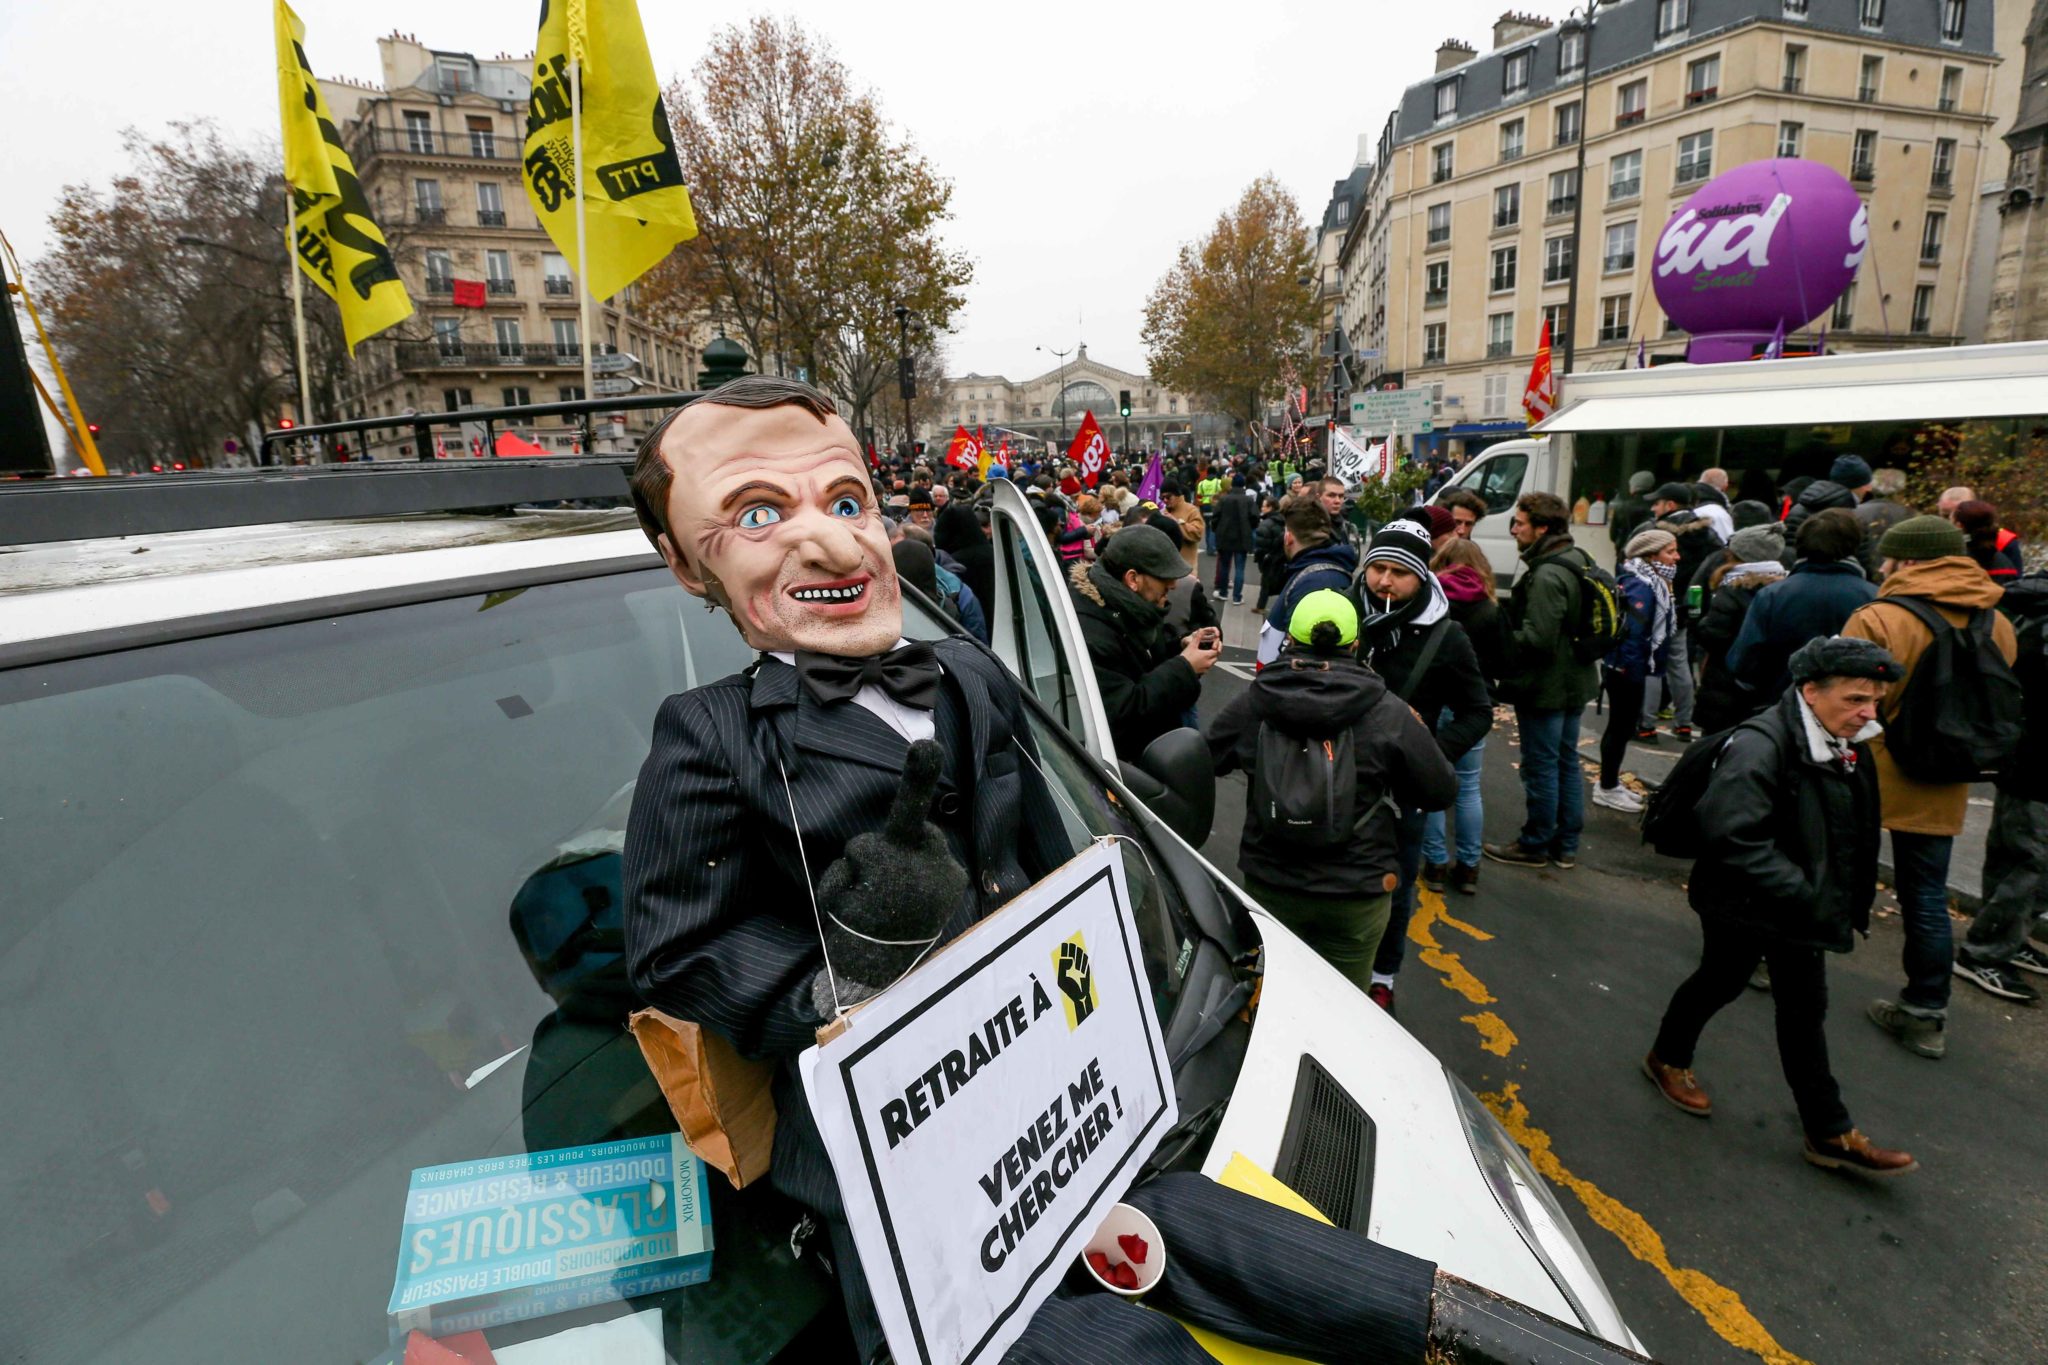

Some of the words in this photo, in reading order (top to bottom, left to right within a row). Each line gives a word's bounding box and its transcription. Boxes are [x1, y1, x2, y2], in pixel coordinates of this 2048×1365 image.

[1696, 201, 1763, 220] Solidaires
[880, 995, 1028, 1150] RETRAITE
[1029, 972, 1052, 1022] À
[650, 1139, 665, 1148] 110
[978, 1094, 1068, 1207] VENEZ
[1068, 1056, 1104, 1118] ME
[478, 1161, 504, 1173] GROS
[538, 1154, 554, 1164] LES
[558, 1150, 584, 1161] POUR
[421, 1166, 473, 1183] CHAGRINS
[577, 1157, 666, 1188] DOUCEUR
[980, 1102, 1113, 1273] CHERCHER
[416, 1174, 547, 1217] RÉSISTANCE
[679, 1159, 695, 1223] MONOPRIX
[410, 1187, 668, 1275] CLASSIQUES
[650, 1238, 672, 1254] 110
[494, 1258, 551, 1285] DOUBLE
[560, 1241, 644, 1272] MOUCHOIRS
[401, 1269, 488, 1305] ÉPAISSEUR
[441, 1300, 546, 1333] DOUCEUR
